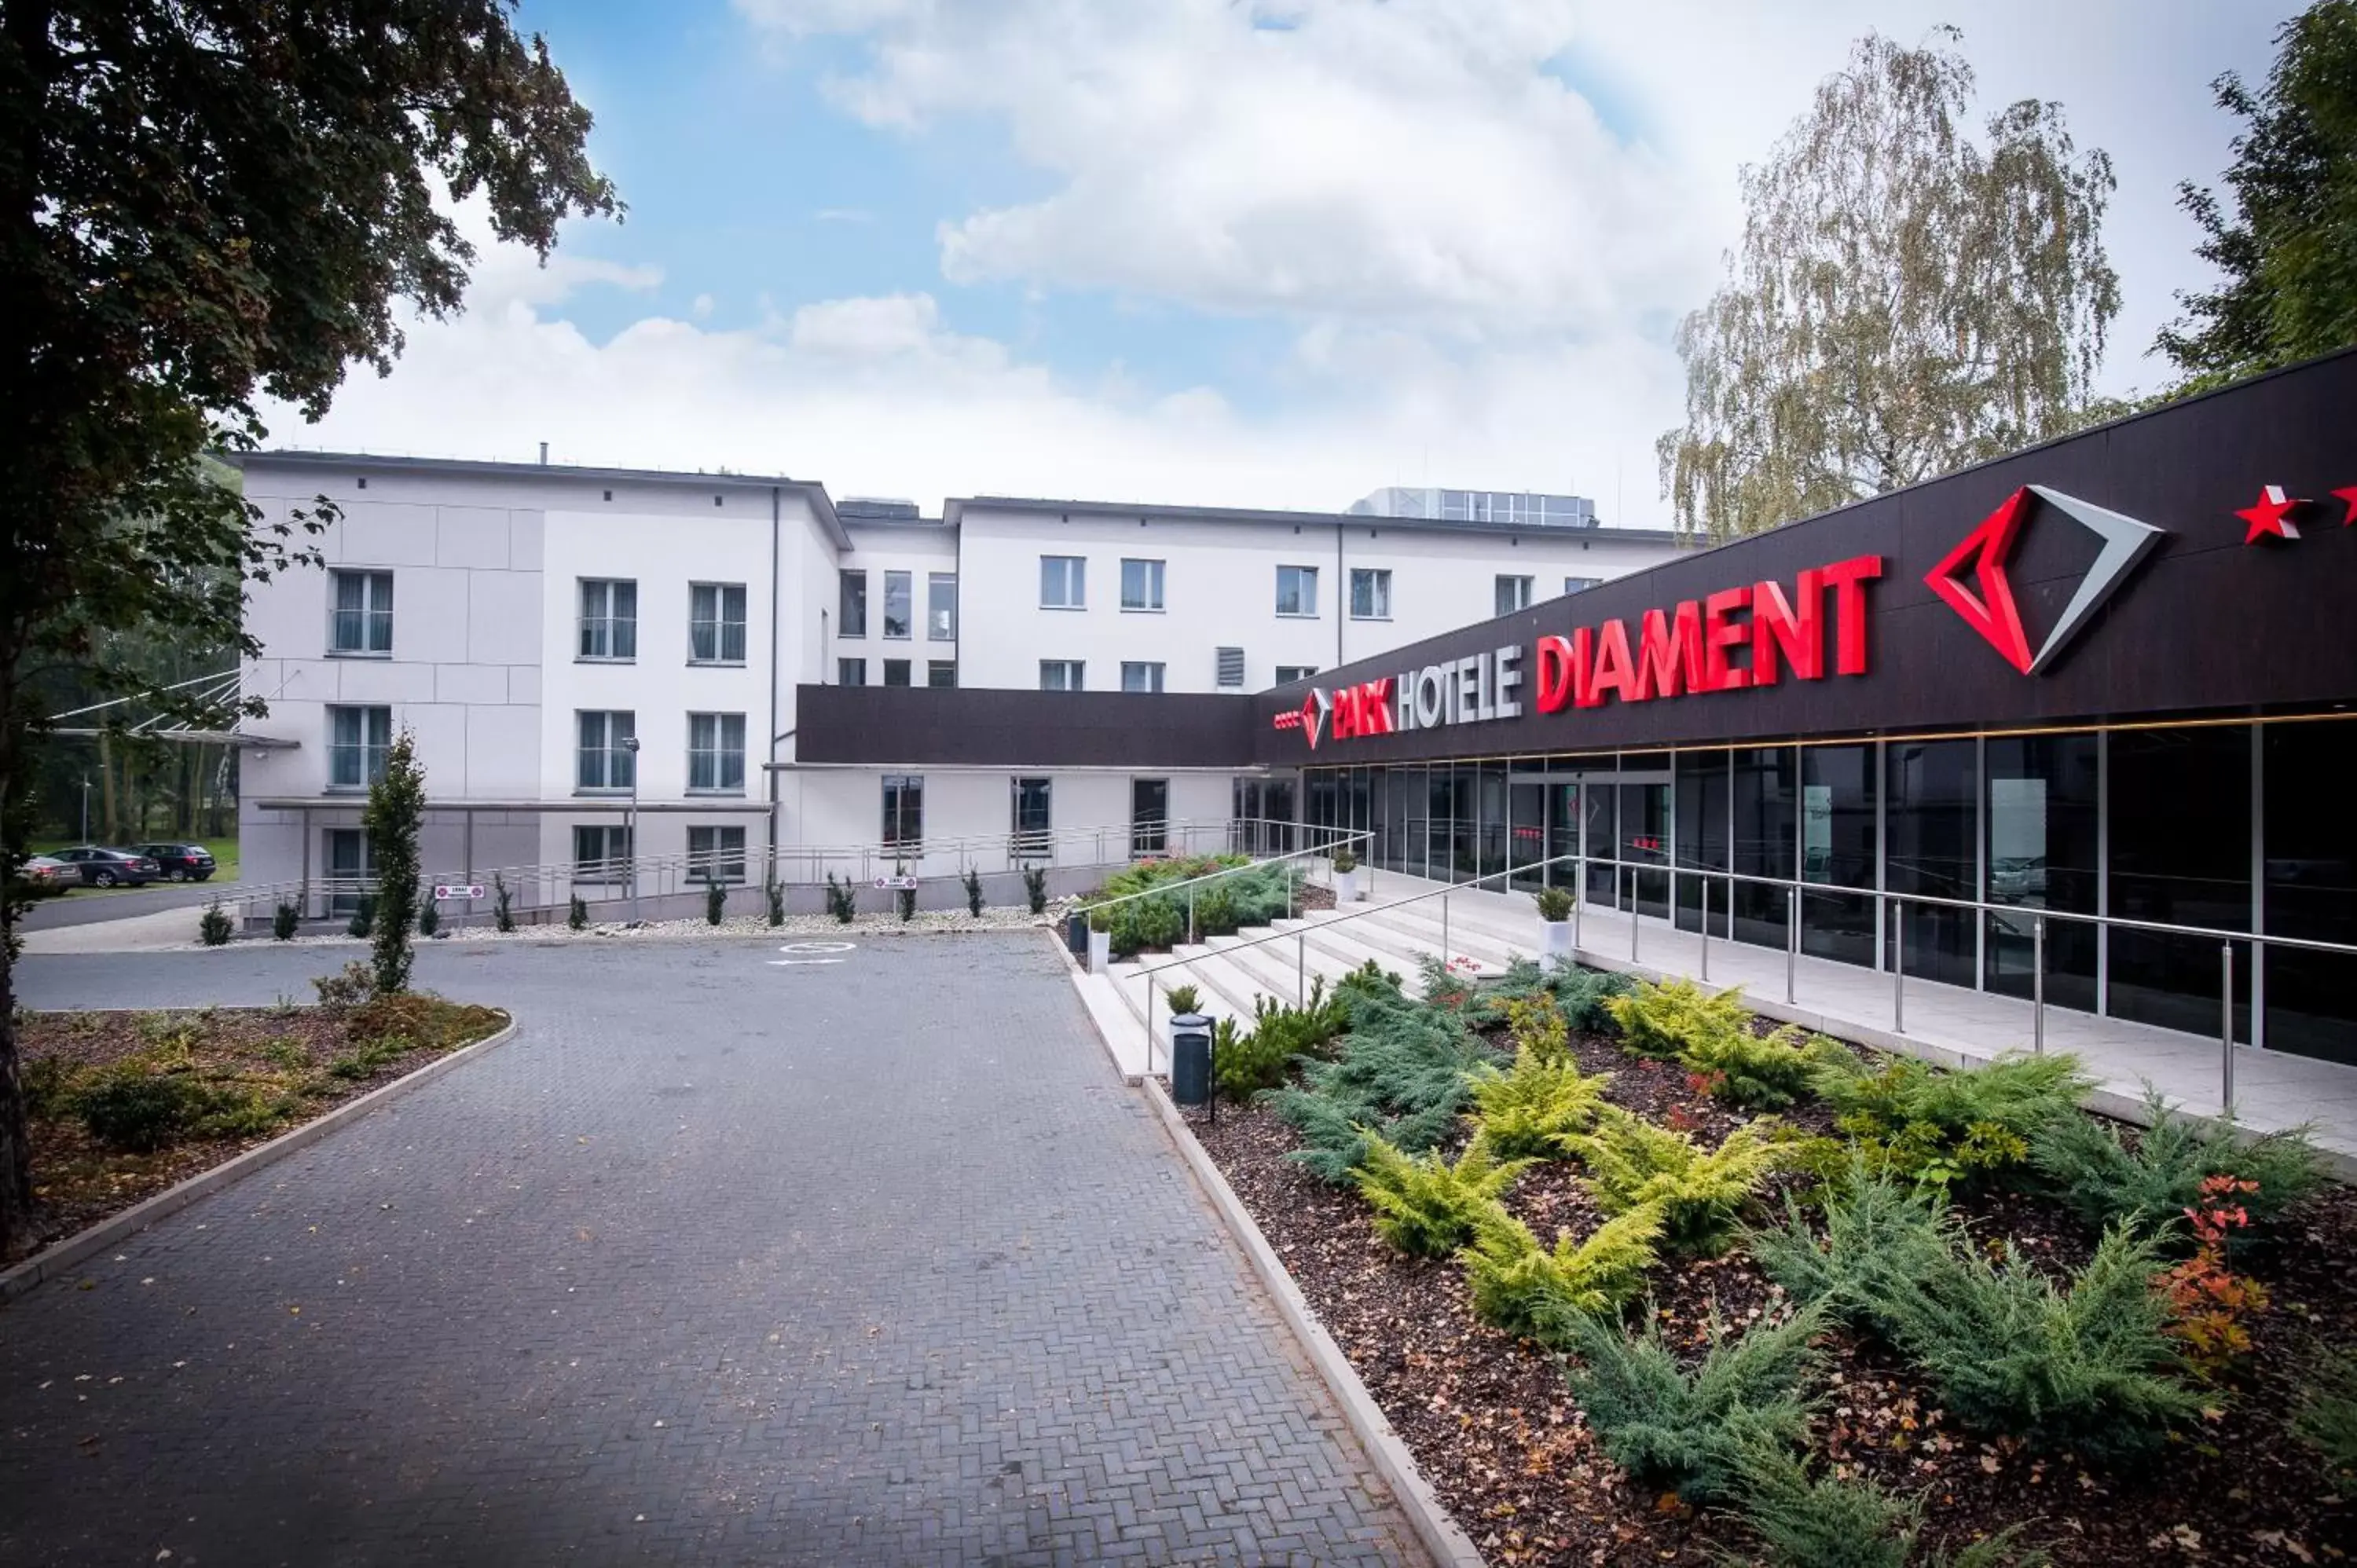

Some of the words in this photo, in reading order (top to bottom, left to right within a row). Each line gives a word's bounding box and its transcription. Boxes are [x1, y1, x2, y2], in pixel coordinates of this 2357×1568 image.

[1332, 677, 1395, 738] PARK
[1397, 645, 1522, 731] HOTELE
[1537, 555, 1882, 713] DIAMENT
